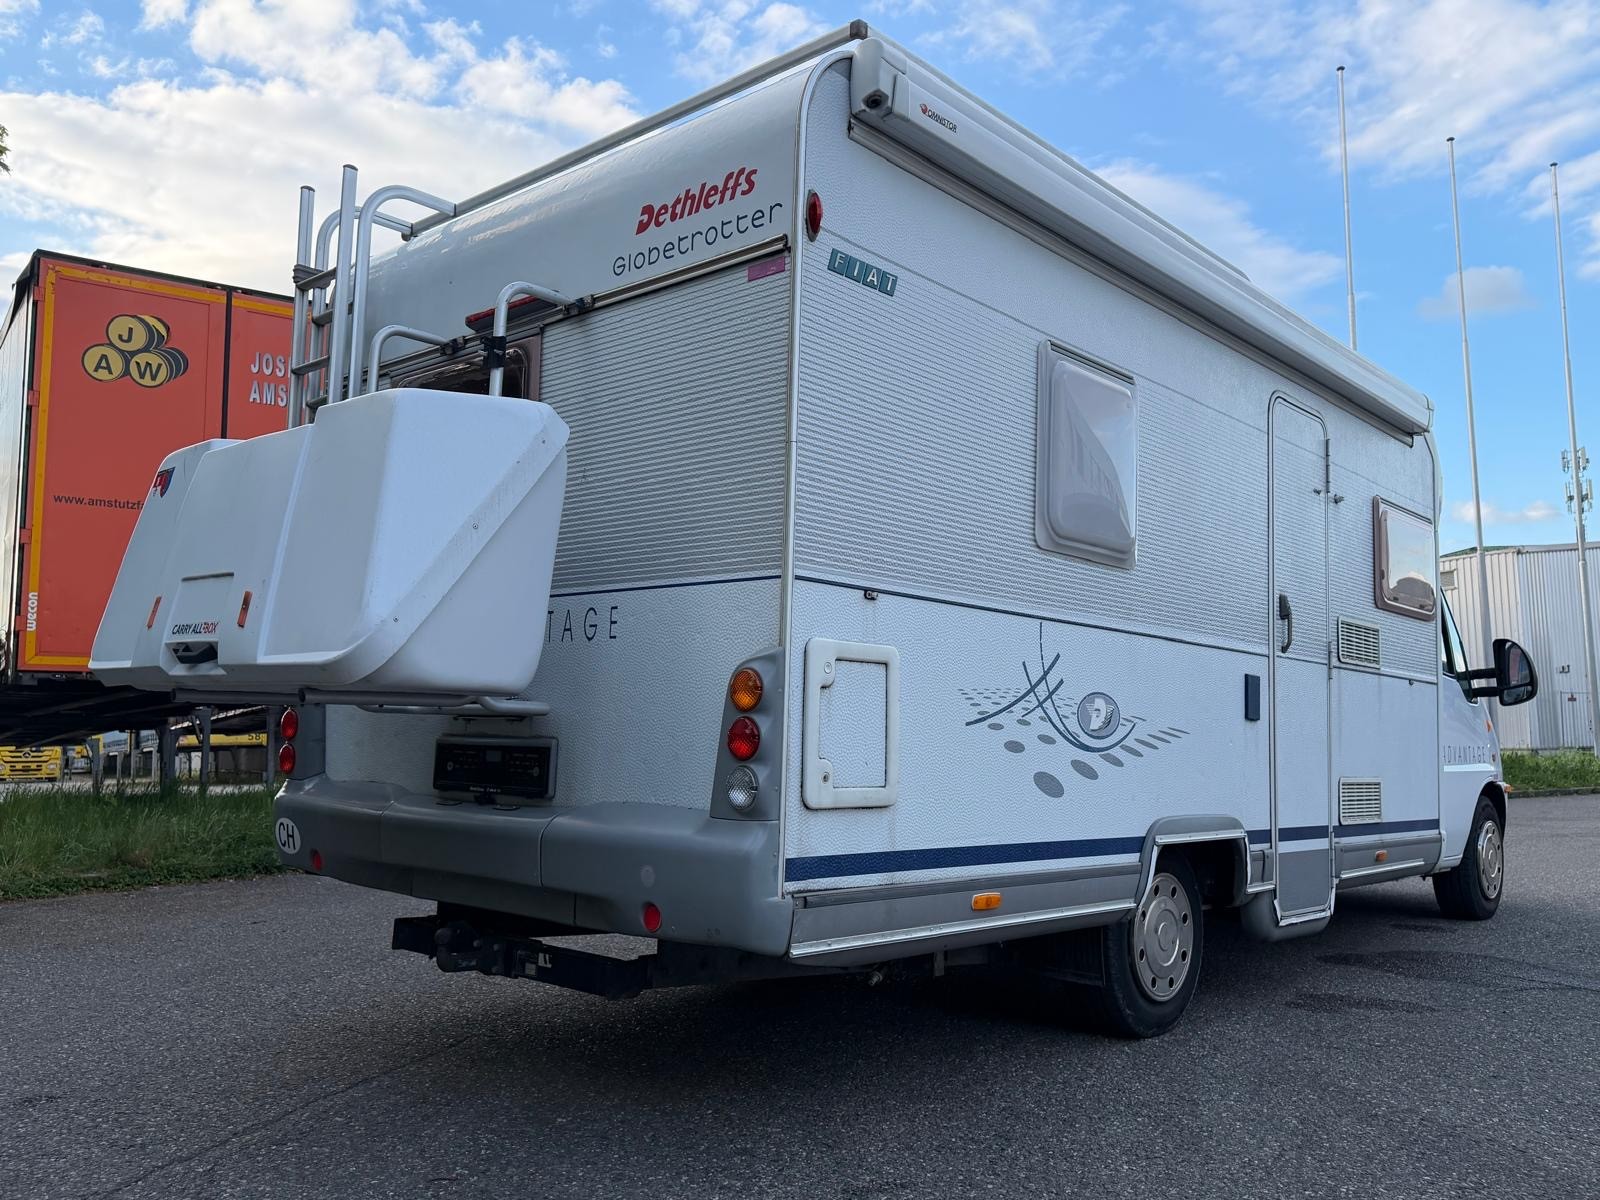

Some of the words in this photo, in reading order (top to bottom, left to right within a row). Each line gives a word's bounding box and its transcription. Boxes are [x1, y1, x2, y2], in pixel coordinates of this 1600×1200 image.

[927, 109, 958, 133] OMNISTOR
[635, 166, 758, 236] Dethleffs
[612, 202, 783, 277] Globetrotter
[832, 252, 897, 292] FIAT
[249, 379, 289, 408] AMS
[26, 591, 39, 632] wecon
[278, 821, 297, 851] CH
